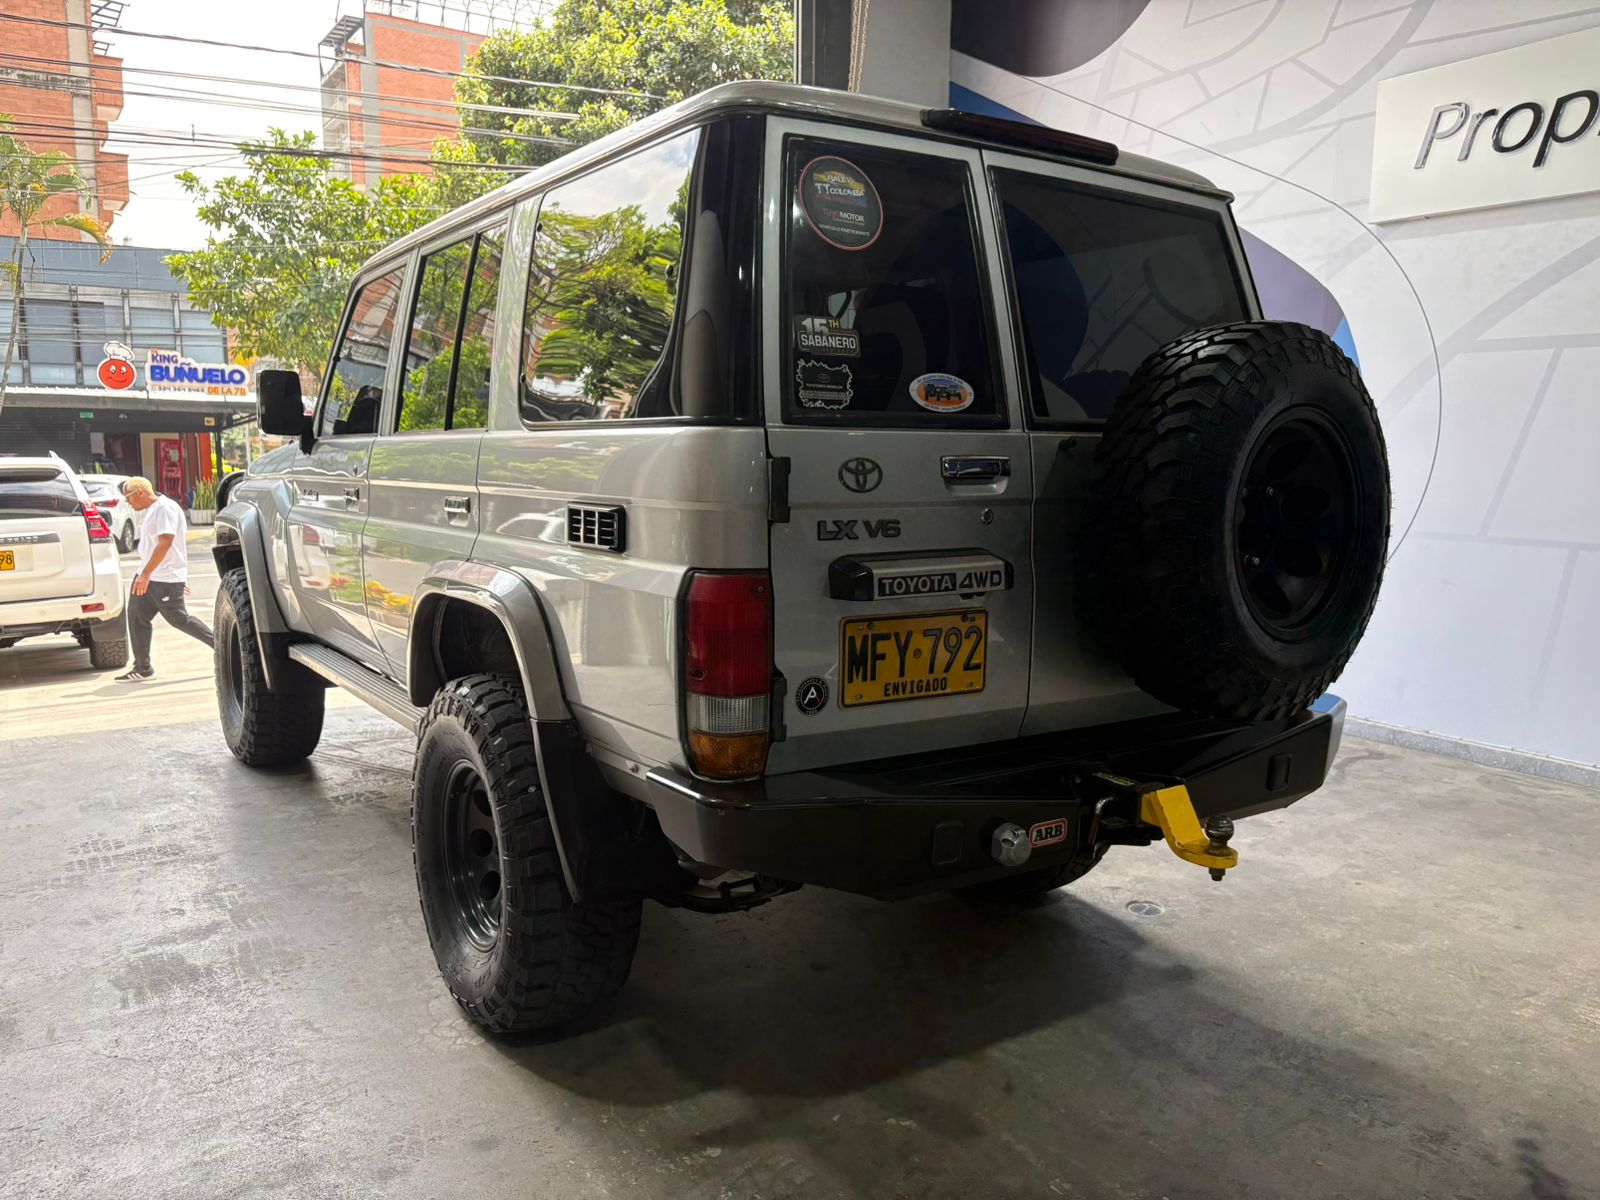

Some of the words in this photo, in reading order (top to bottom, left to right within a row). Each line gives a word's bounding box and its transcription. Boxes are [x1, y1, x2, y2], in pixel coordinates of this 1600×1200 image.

[1413, 89, 1600, 170] Prop
[800, 334, 857, 349] SABANERO
[151, 353, 179, 365] KING
[150, 362, 246, 385] BUÑUELO
[207, 386, 219, 395] DE
[221, 387, 232, 396] LA
[817, 520, 859, 541] LX
[862, 519, 901, 539] V6
[881, 575, 953, 595] TOYOTA
[958, 570, 1003, 589] 4WD
[847, 630, 913, 684] MFY
[922, 625, 983, 676] 792
[883, 676, 948, 698] ENVIGADO
[1033, 823, 1064, 843] ARB
